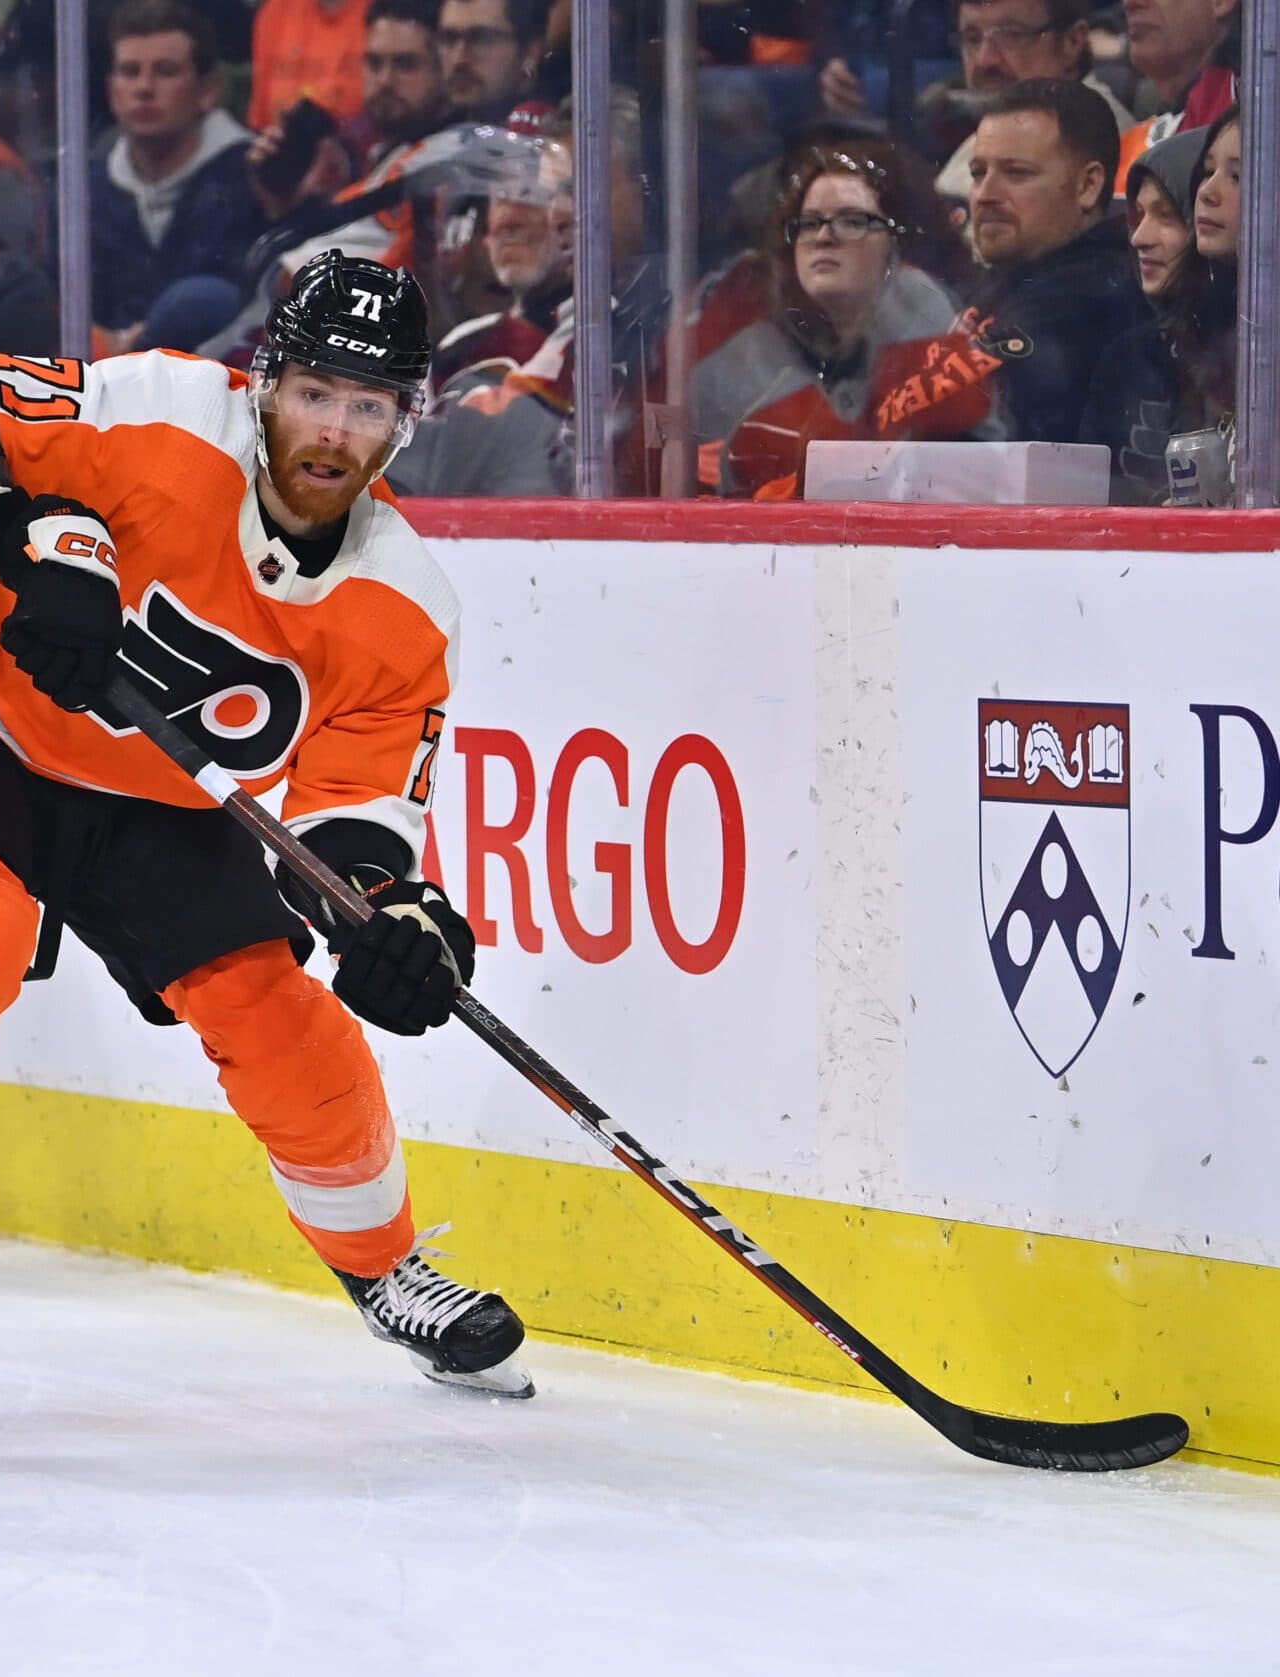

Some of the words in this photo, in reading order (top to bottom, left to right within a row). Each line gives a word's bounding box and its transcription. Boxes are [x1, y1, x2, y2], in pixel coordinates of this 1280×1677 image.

[351, 287, 382, 322] 71
[326, 333, 387, 358] CCM
[464, 1001, 498, 1031] PRO
[813, 1320, 865, 1361] CCM
